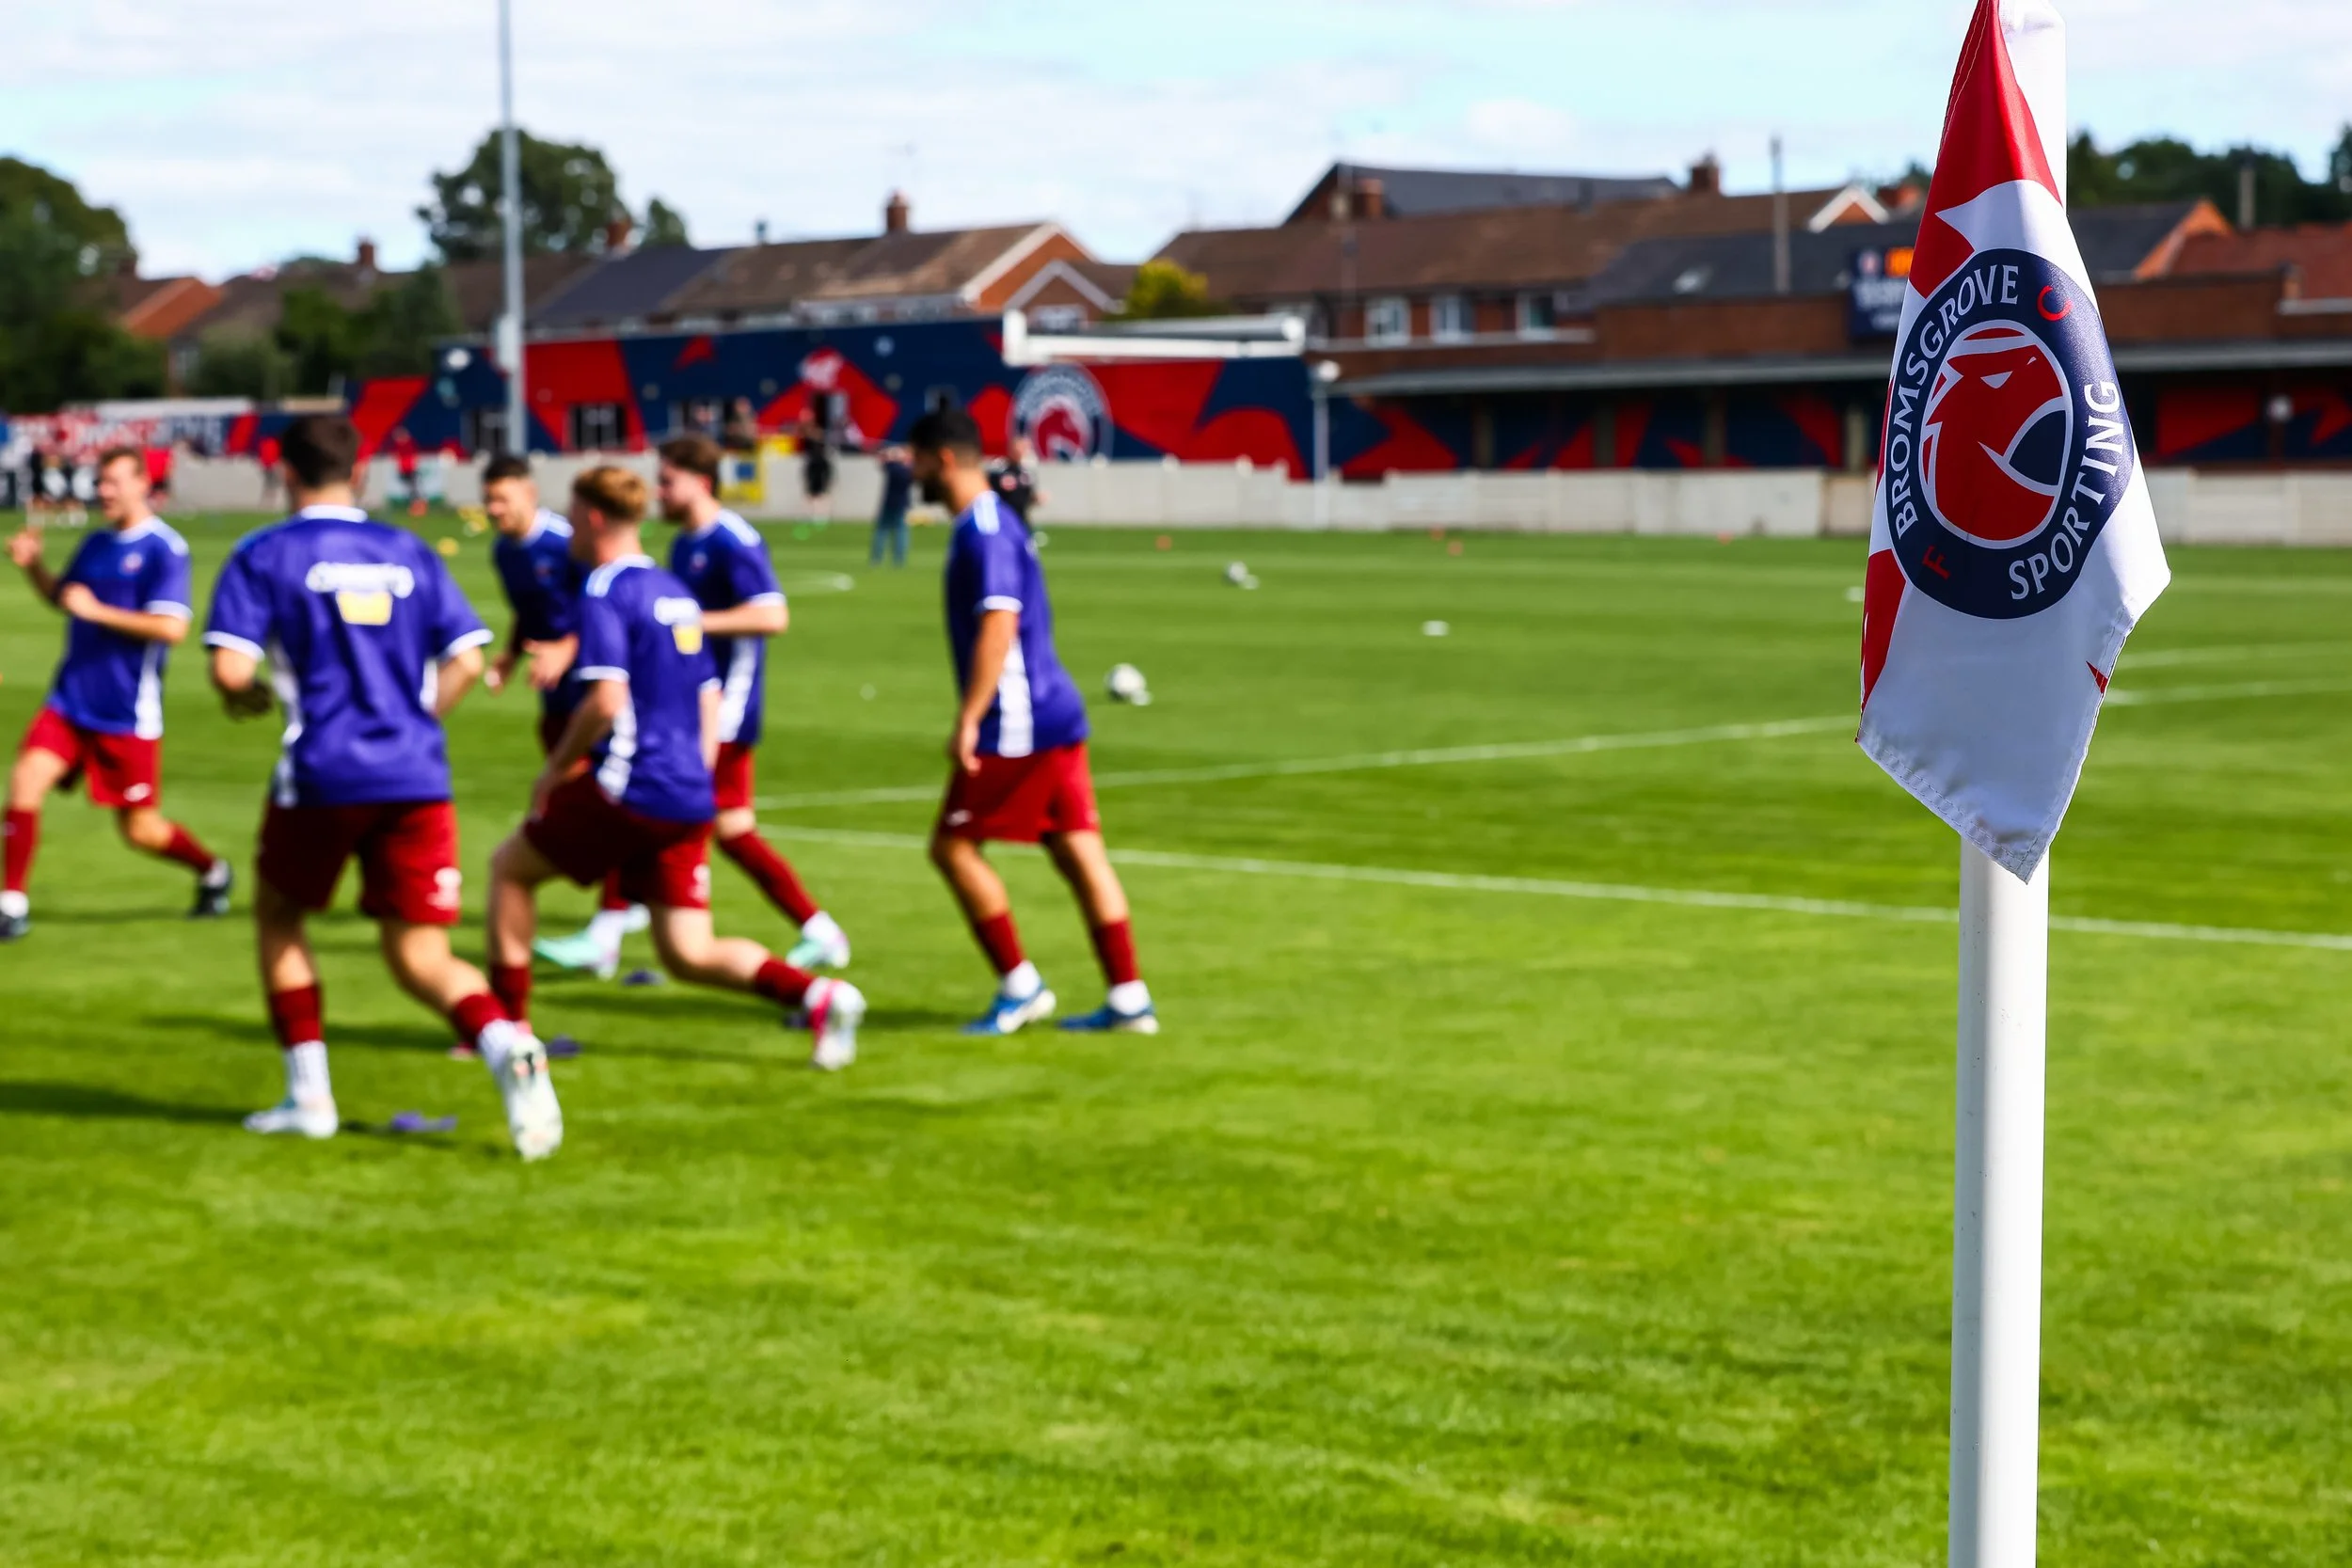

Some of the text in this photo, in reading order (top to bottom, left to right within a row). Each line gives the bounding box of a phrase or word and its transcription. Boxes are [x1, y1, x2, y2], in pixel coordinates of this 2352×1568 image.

[2037, 286, 2072, 321] C
[1891, 264, 2018, 539] BROMSGROVE
[2009, 381, 2123, 600] SPORTING
[1923, 546, 1950, 579] F
